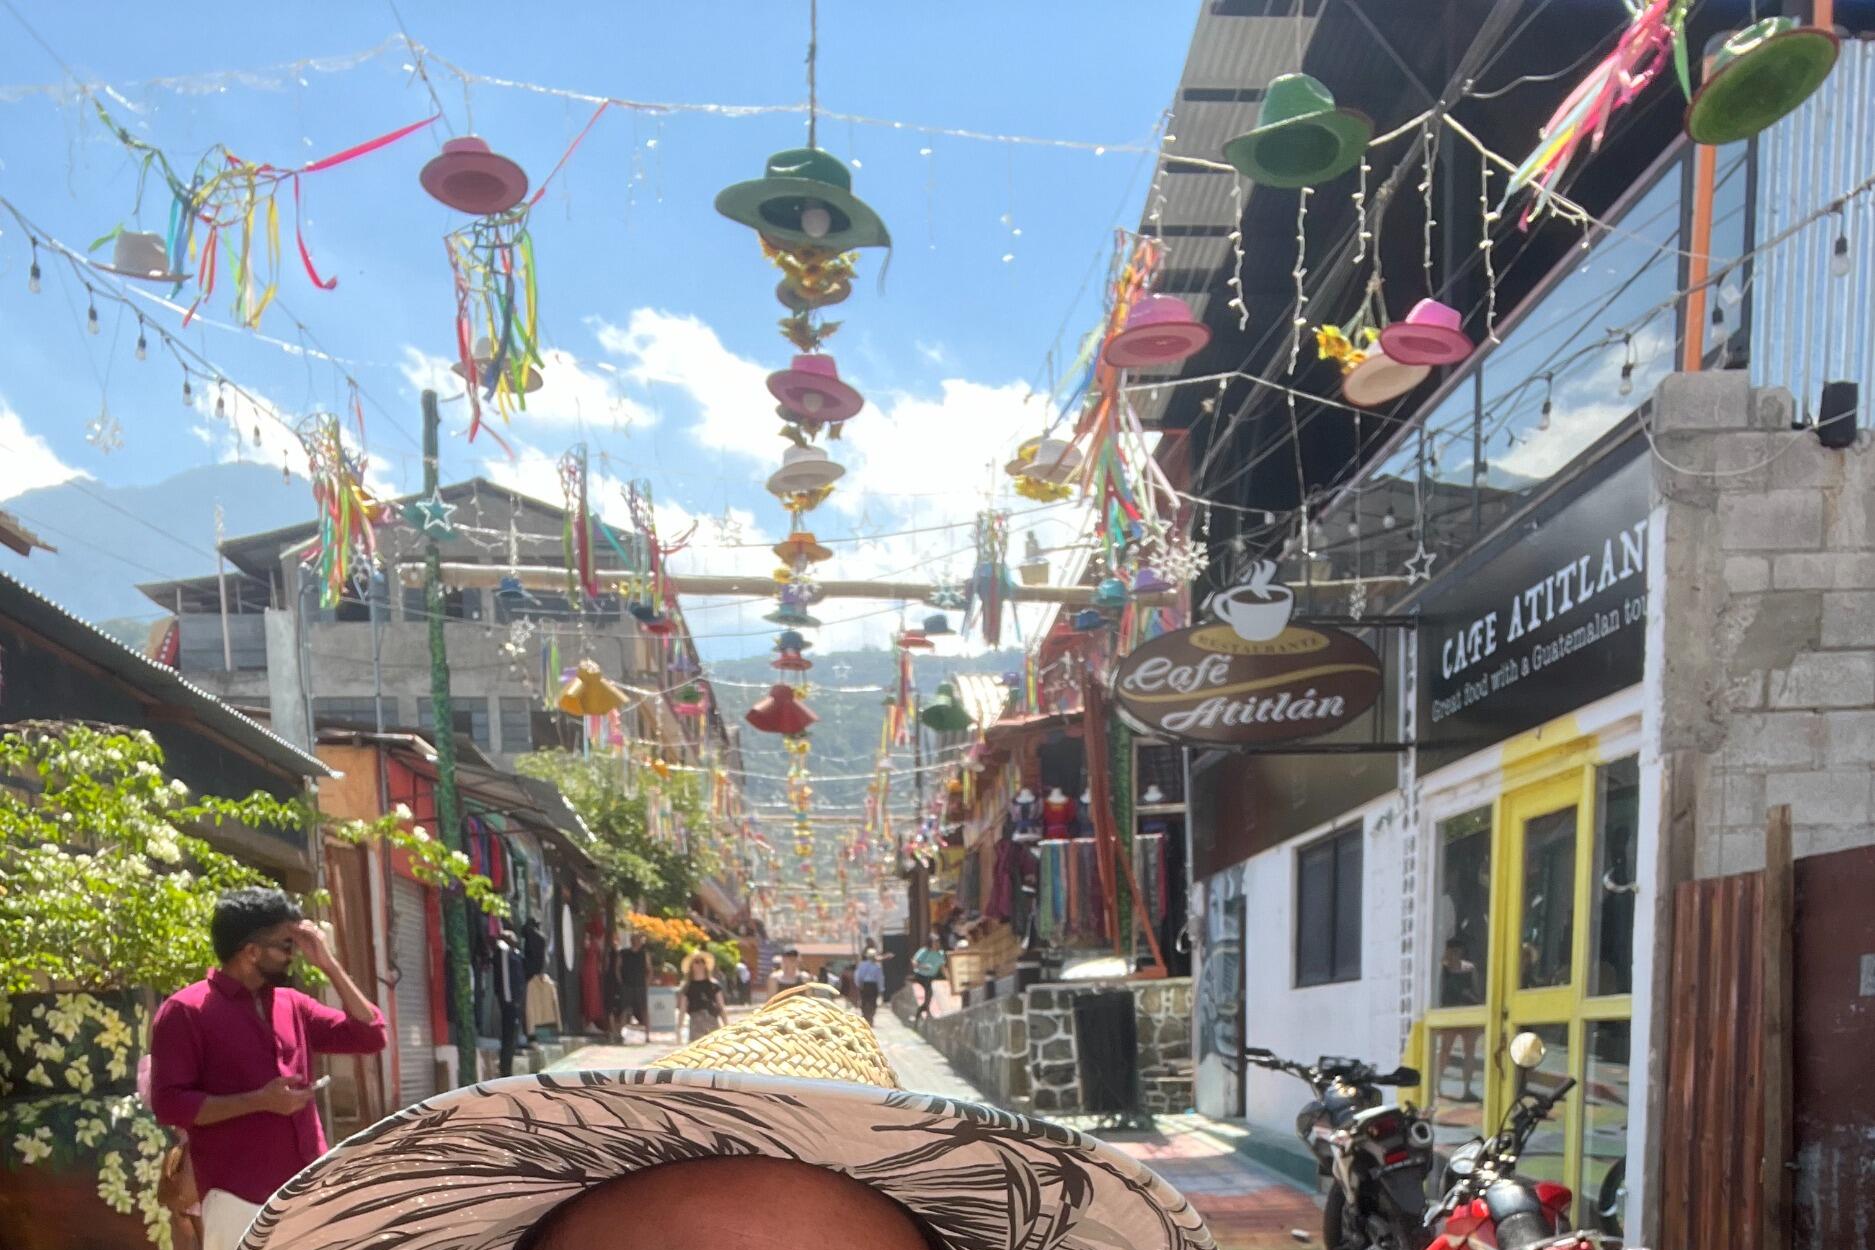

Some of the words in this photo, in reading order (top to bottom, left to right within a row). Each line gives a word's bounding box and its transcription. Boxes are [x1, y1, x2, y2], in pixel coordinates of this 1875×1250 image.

[1441, 611, 1498, 680] CAFE
[1506, 518, 1648, 643] ATITLAN
[1123, 653, 1233, 693] Café
[1490, 658, 1519, 692] with
[1521, 655, 1531, 678] a
[1532, 608, 1620, 672] Guatemalan
[1160, 688, 1345, 731] Atitlán
